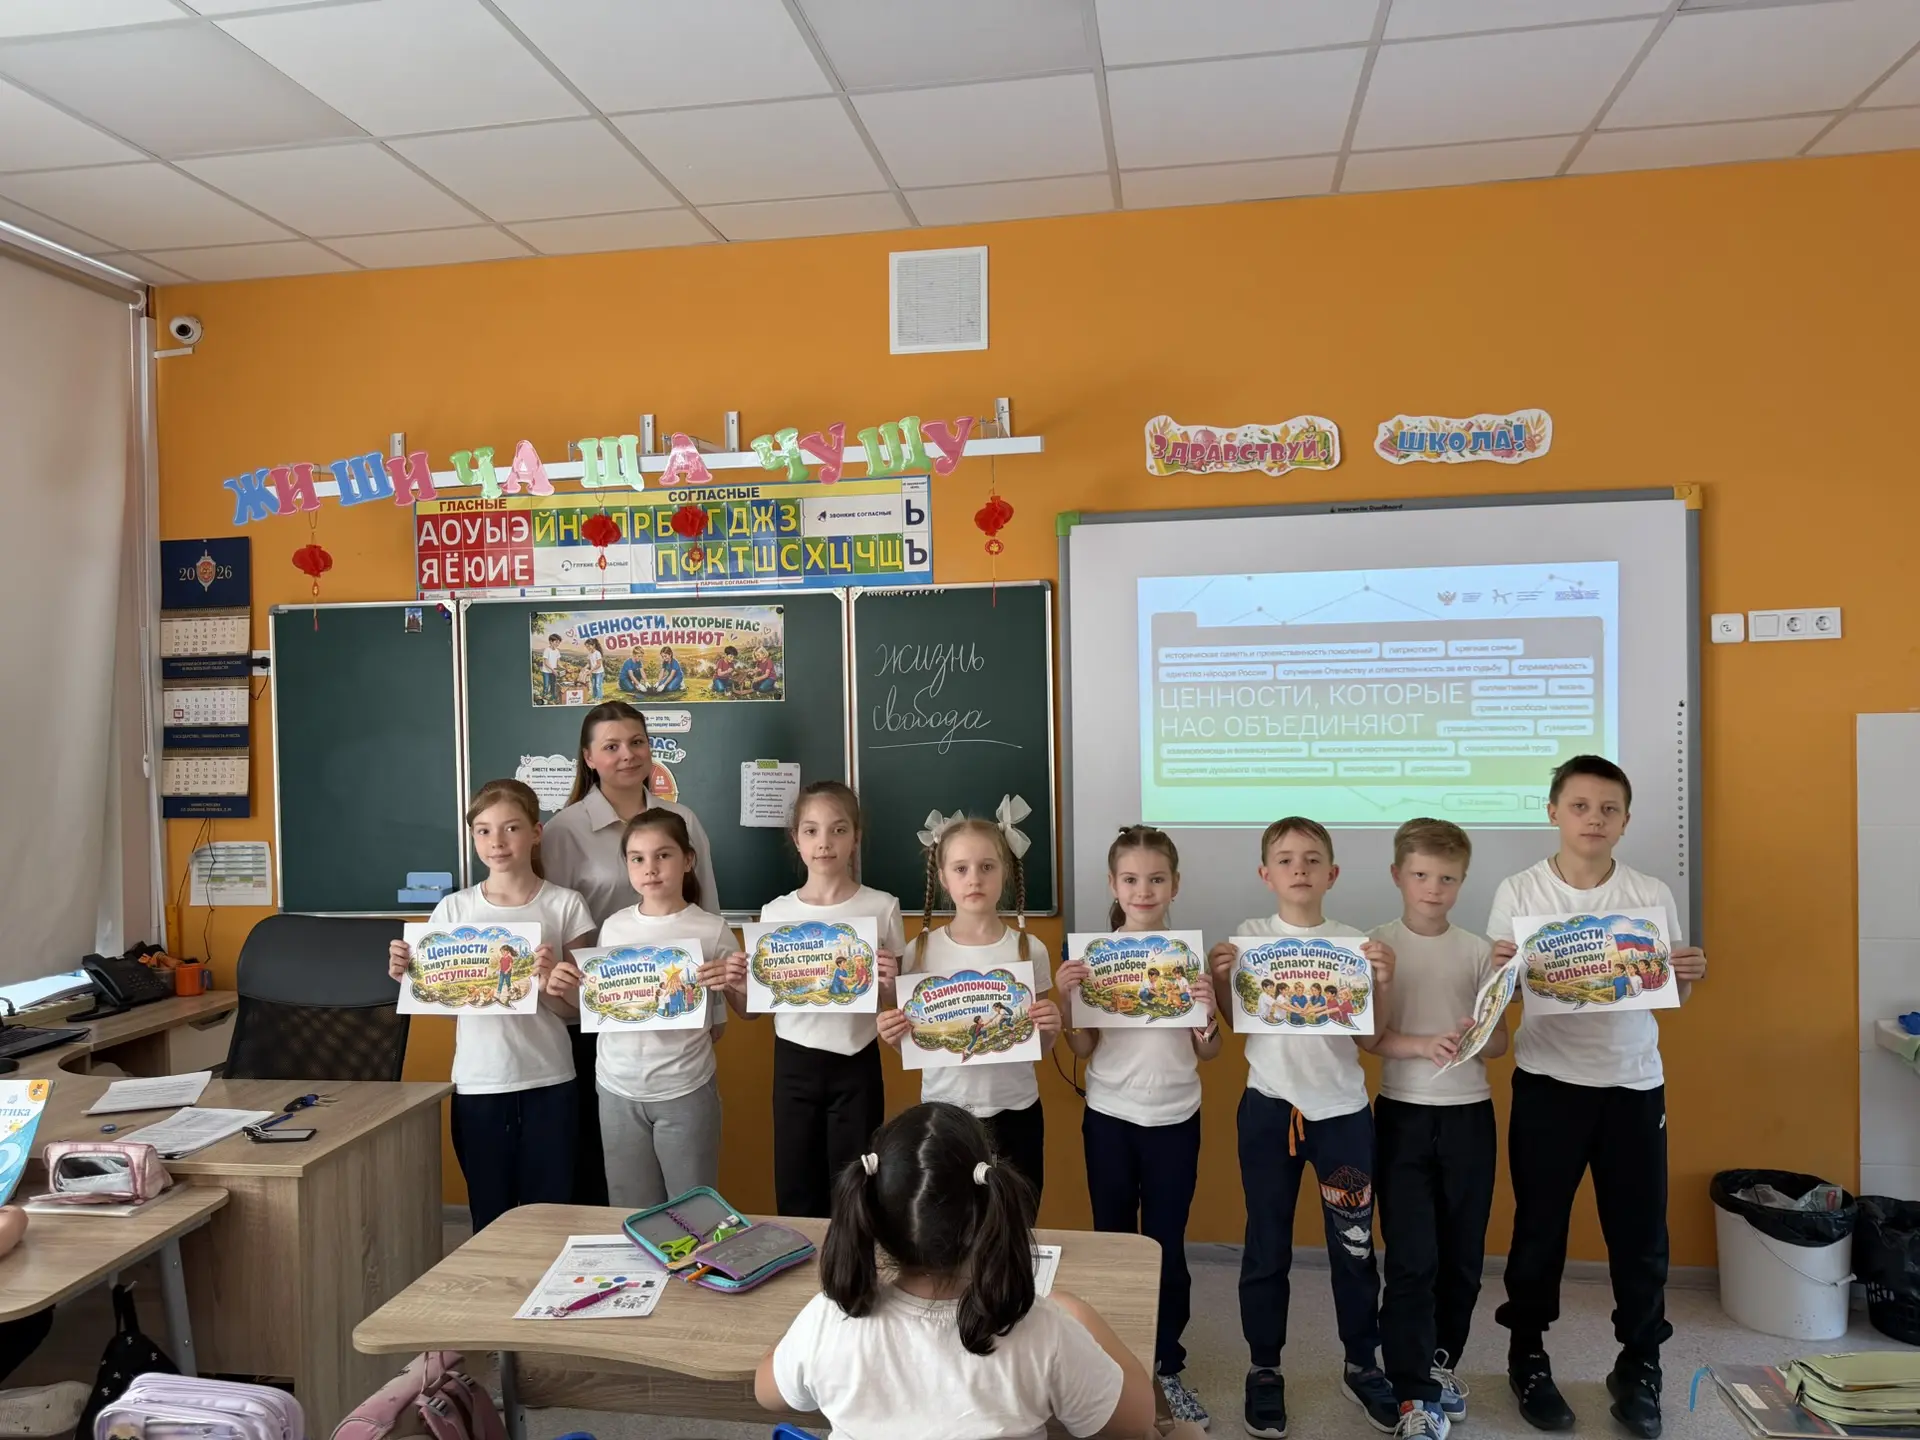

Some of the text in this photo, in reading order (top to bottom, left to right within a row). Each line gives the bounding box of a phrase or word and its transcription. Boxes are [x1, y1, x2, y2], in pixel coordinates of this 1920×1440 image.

[1151, 431, 1329, 464] ЗДРАВСТВУЙ,
[1397, 424, 1526, 454] ШКОЛА!
[223, 462, 322, 526] ЖИ
[329, 451, 438, 507] ШИ
[450, 439, 555, 500] ЧА
[577, 432, 712, 492] ЩА
[750, 421, 846, 485] ЧУ
[668, 487, 760, 502] СОГЛАСНЫЕ
[439, 499, 507, 512] ГЛАСНЫЕ
[857, 510, 892, 518] СОГЛАСНЫЕ
[179, 565, 233, 581] 20 26
[577, 615, 761, 639] ЦЕННОСТИ, КОТОРЫЕ НАС
[605, 630, 725, 651] ОБЪЕДИНЯЮТ
[874, 642, 985, 698] жизнь
[1160, 683, 1466, 712] ЦЕННОСТИ, КОТОРЫЕ
[873, 685, 992, 755] свобода
[1161, 713, 1425, 739] НАС ОБЪЕДИНЯЮТ
[770, 939, 824, 954] Настоящая
[1536, 928, 1604, 953] Ценности
[426, 943, 488, 960] Ценности
[1088, 949, 1150, 967] Забота делает
[1251, 947, 1358, 966] Добрые ценности
[1553, 941, 1604, 960] делают
[423, 956, 490, 972] живут в наших
[763, 952, 833, 968] дружба строится
[1094, 960, 1146, 977] мир добрее
[1269, 959, 1339, 972] делают нас
[1544, 951, 1606, 970] нашу страну
[425, 967, 488, 985] поступках!
[599, 962, 656, 979] Ценности
[771, 964, 830, 980] на уважении!
[1274, 970, 1331, 981] сильнее!
[1546, 959, 1612, 984] сильнее!
[598, 974, 660, 991] помогают нам
[1093, 972, 1144, 990] и светлее!
[598, 986, 655, 1004] быть лучше!
[922, 981, 1007, 1003] Взаимопомощь
[923, 993, 1012, 1014] помогает справляться
[928, 1005, 989, 1024] с трудностями!
